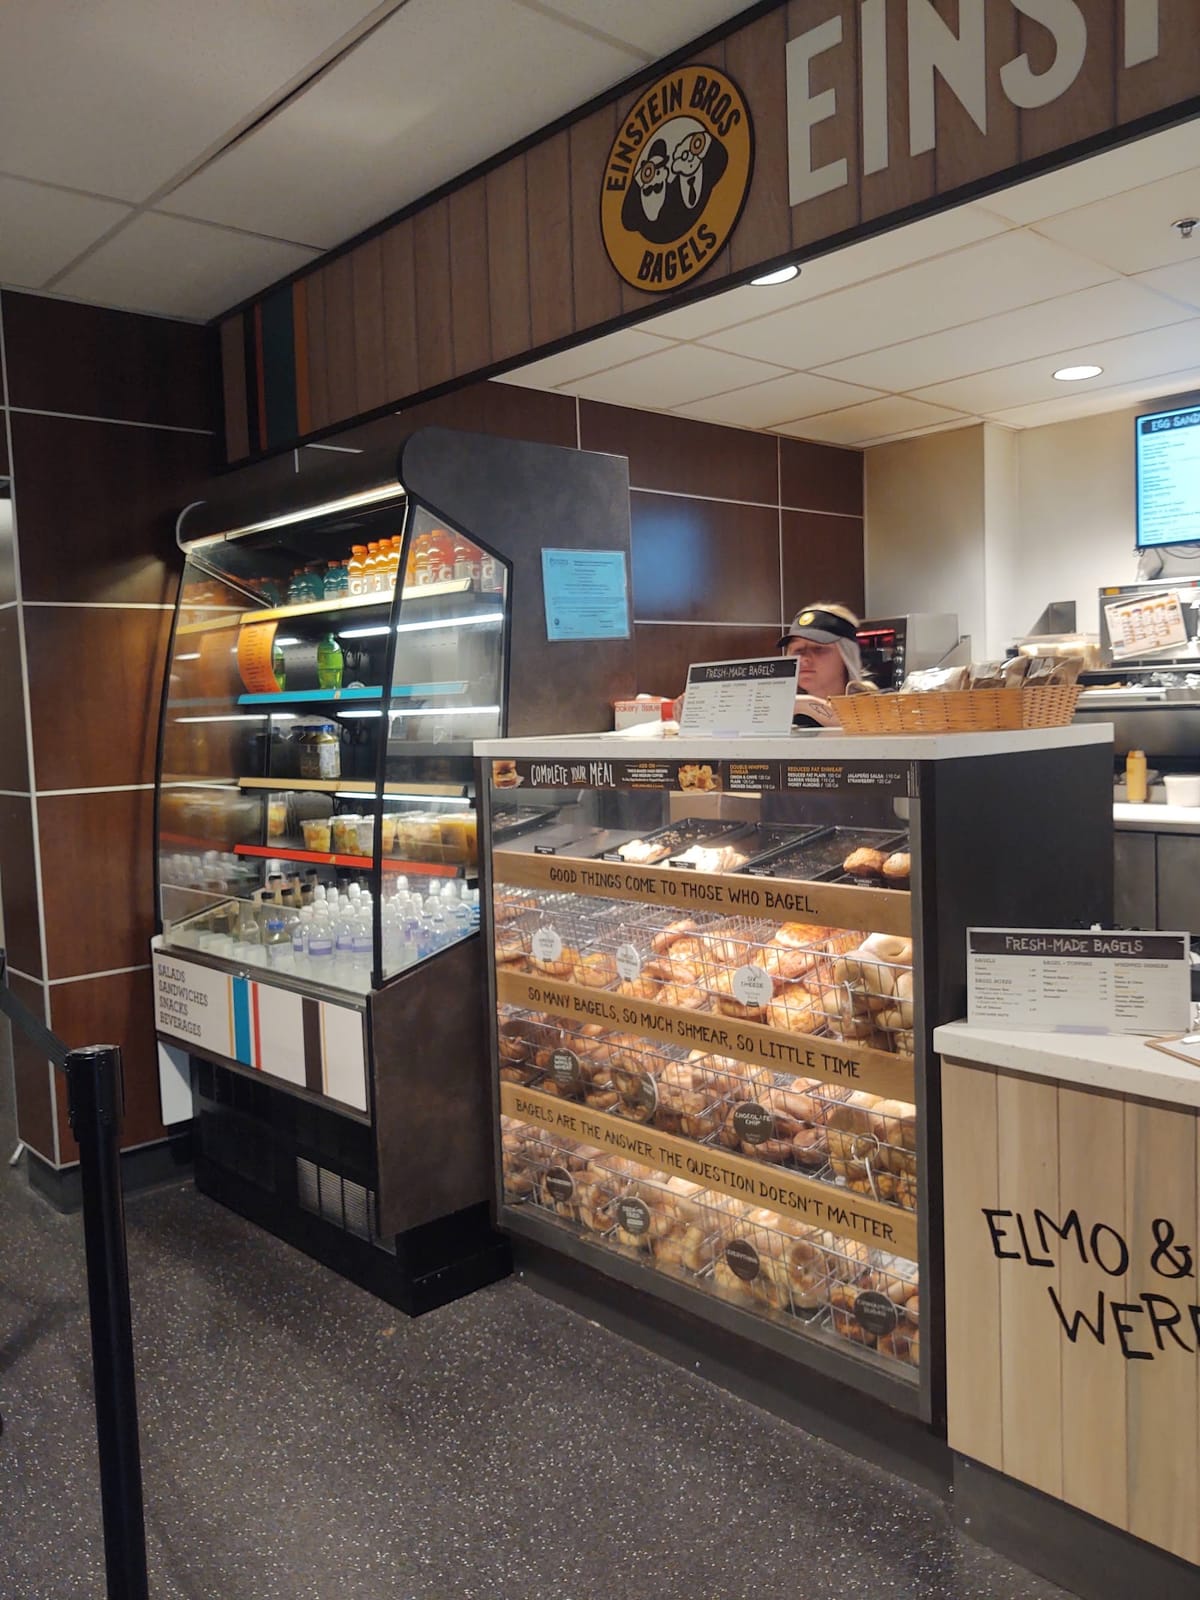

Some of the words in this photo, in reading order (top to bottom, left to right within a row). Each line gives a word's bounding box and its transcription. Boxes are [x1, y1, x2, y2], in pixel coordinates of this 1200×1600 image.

[606, 78, 684, 192] EINSTEIN
[689, 75, 741, 137] BROS
[637, 223, 718, 283] BAGELS
[705, 667, 748, 679] FRESH-MADE
[748, 663, 775, 676] BAGELS
[530, 764, 569, 786] COMPLETE
[589, 762, 616, 788] MEAL
[550, 867, 578, 884] GOOD
[581, 871, 622, 890] THINGS
[625, 875, 657, 894] COME
[660, 880, 677, 896] TO
[681, 882, 724, 902] THOSE
[728, 887, 760, 906] WHO
[765, 891, 820, 914] BAGEL.
[1005, 936, 1089, 954] FRESH-MADE
[1093, 939, 1145, 955] BAGELS
[158, 963, 186, 983] SALADS
[159, 979, 209, 1007] SANDWICHES
[159, 996, 189, 1016] SNACKS
[159, 1011, 202, 1037] BEVERAGES
[528, 987, 542, 1001] SO
[543, 989, 572, 1008] MANY
[573, 997, 621, 1024] BAGELS,
[622, 1008, 638, 1025] SO
[640, 1013, 674, 1033] MUCH
[677, 1020, 733, 1050] SHMEAR,
[736, 1034, 755, 1053] SO
[759, 1041, 816, 1069] LITTLE
[821, 1055, 861, 1079] TIME
[516, 1098, 554, 1123] BAGELS
[556, 1112, 577, 1130] ARE
[580, 1118, 601, 1139] THE
[658, 1148, 683, 1169] THE
[686, 1157, 756, 1194] QUESTION
[759, 1182, 824, 1218] DOESN'T
[827, 1204, 898, 1244] MATTER.
[981, 1207, 1129, 1277] ELMO
[1151, 1218, 1195, 1279] &
